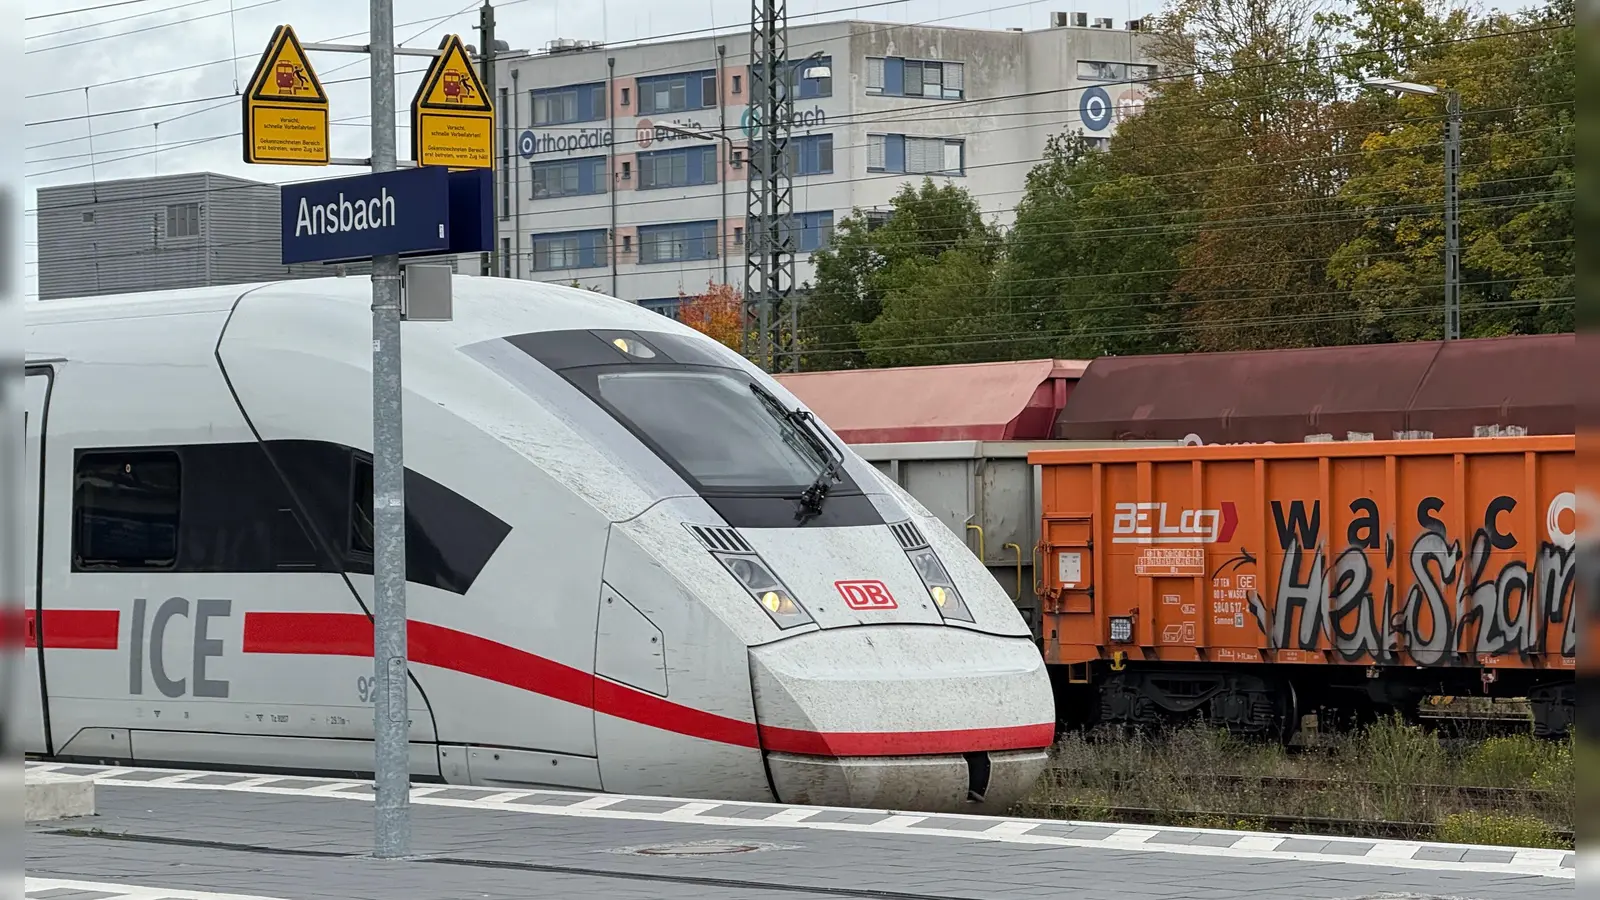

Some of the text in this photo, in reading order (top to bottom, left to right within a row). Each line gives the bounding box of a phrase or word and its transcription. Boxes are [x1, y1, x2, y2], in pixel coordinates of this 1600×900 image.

[295, 187, 396, 237] Ansbach
[843, 584, 889, 605] DB
[1240, 576, 1253, 588] GE
[129, 596, 232, 698] ICE
